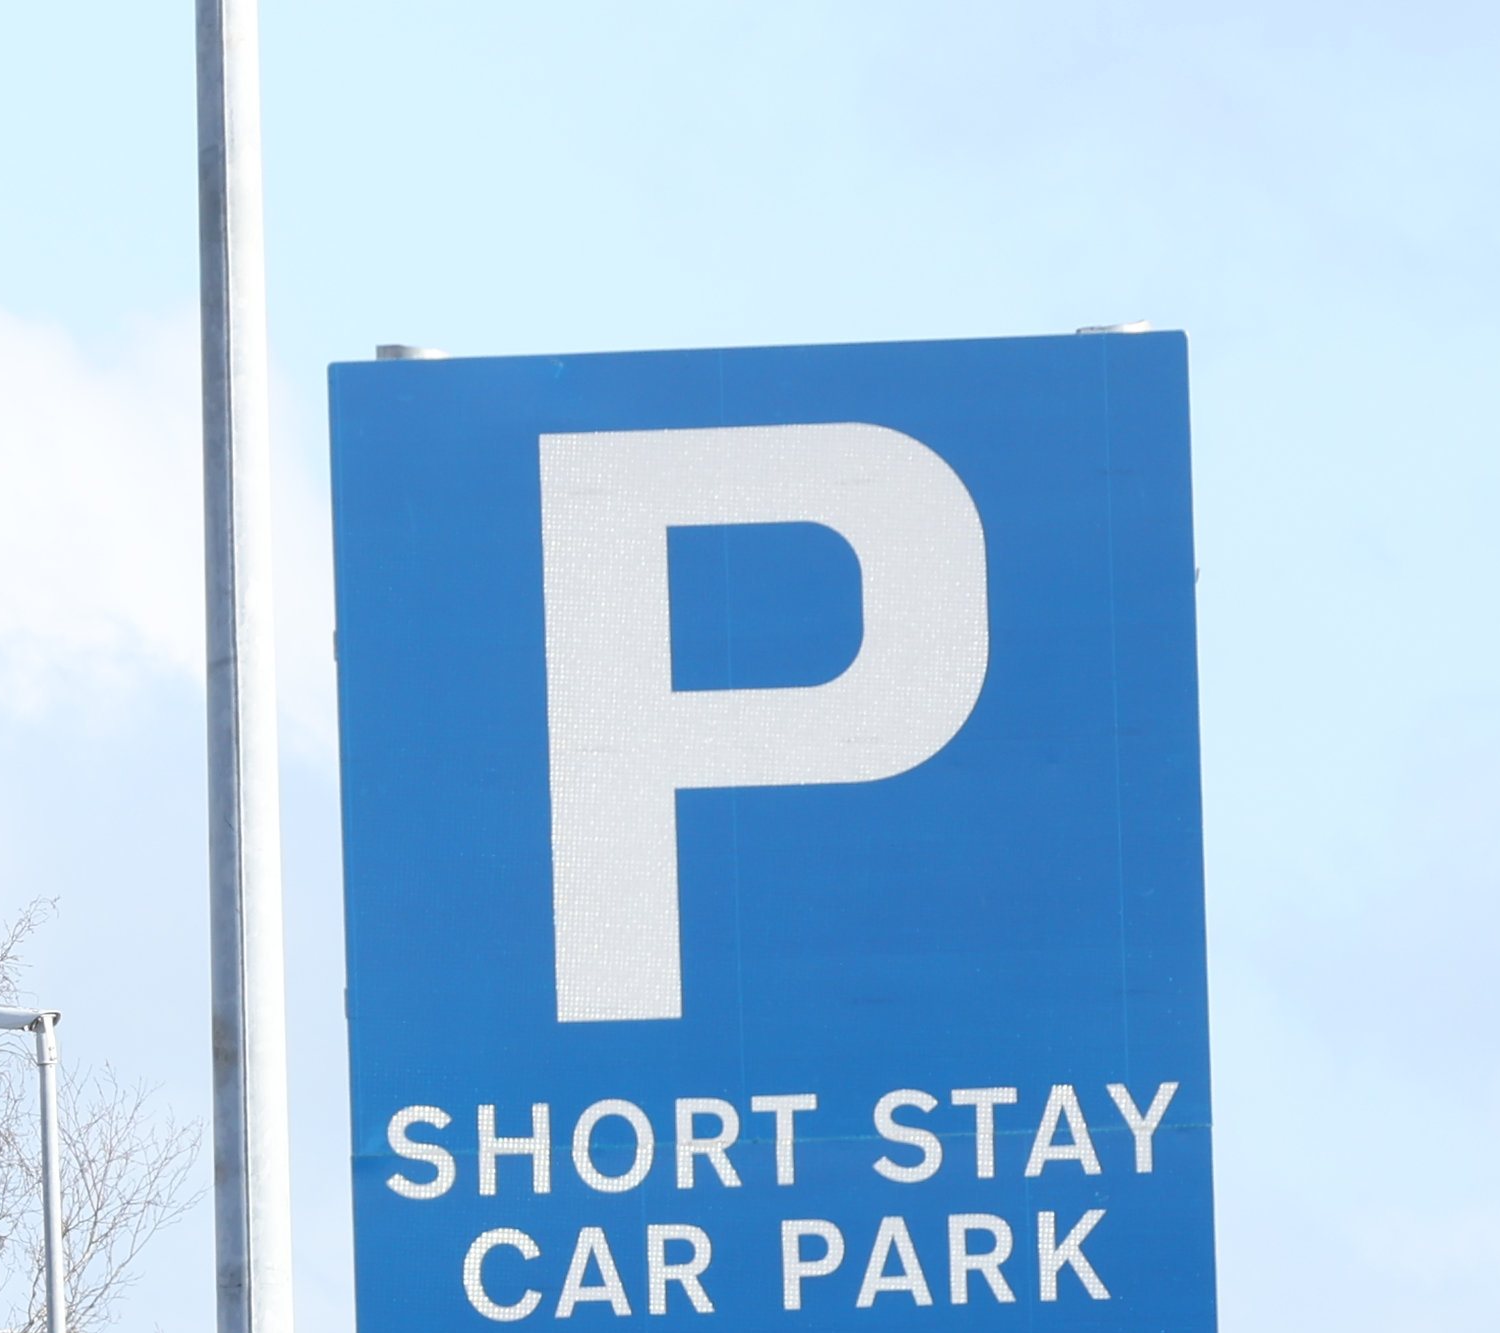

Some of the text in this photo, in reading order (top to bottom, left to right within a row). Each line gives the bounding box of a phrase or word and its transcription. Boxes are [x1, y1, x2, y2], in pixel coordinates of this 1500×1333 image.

[539, 421, 990, 1023] P
[385, 1081, 1180, 1200] SHORT STAY
[462, 1209, 1112, 1322] CAR PARK
